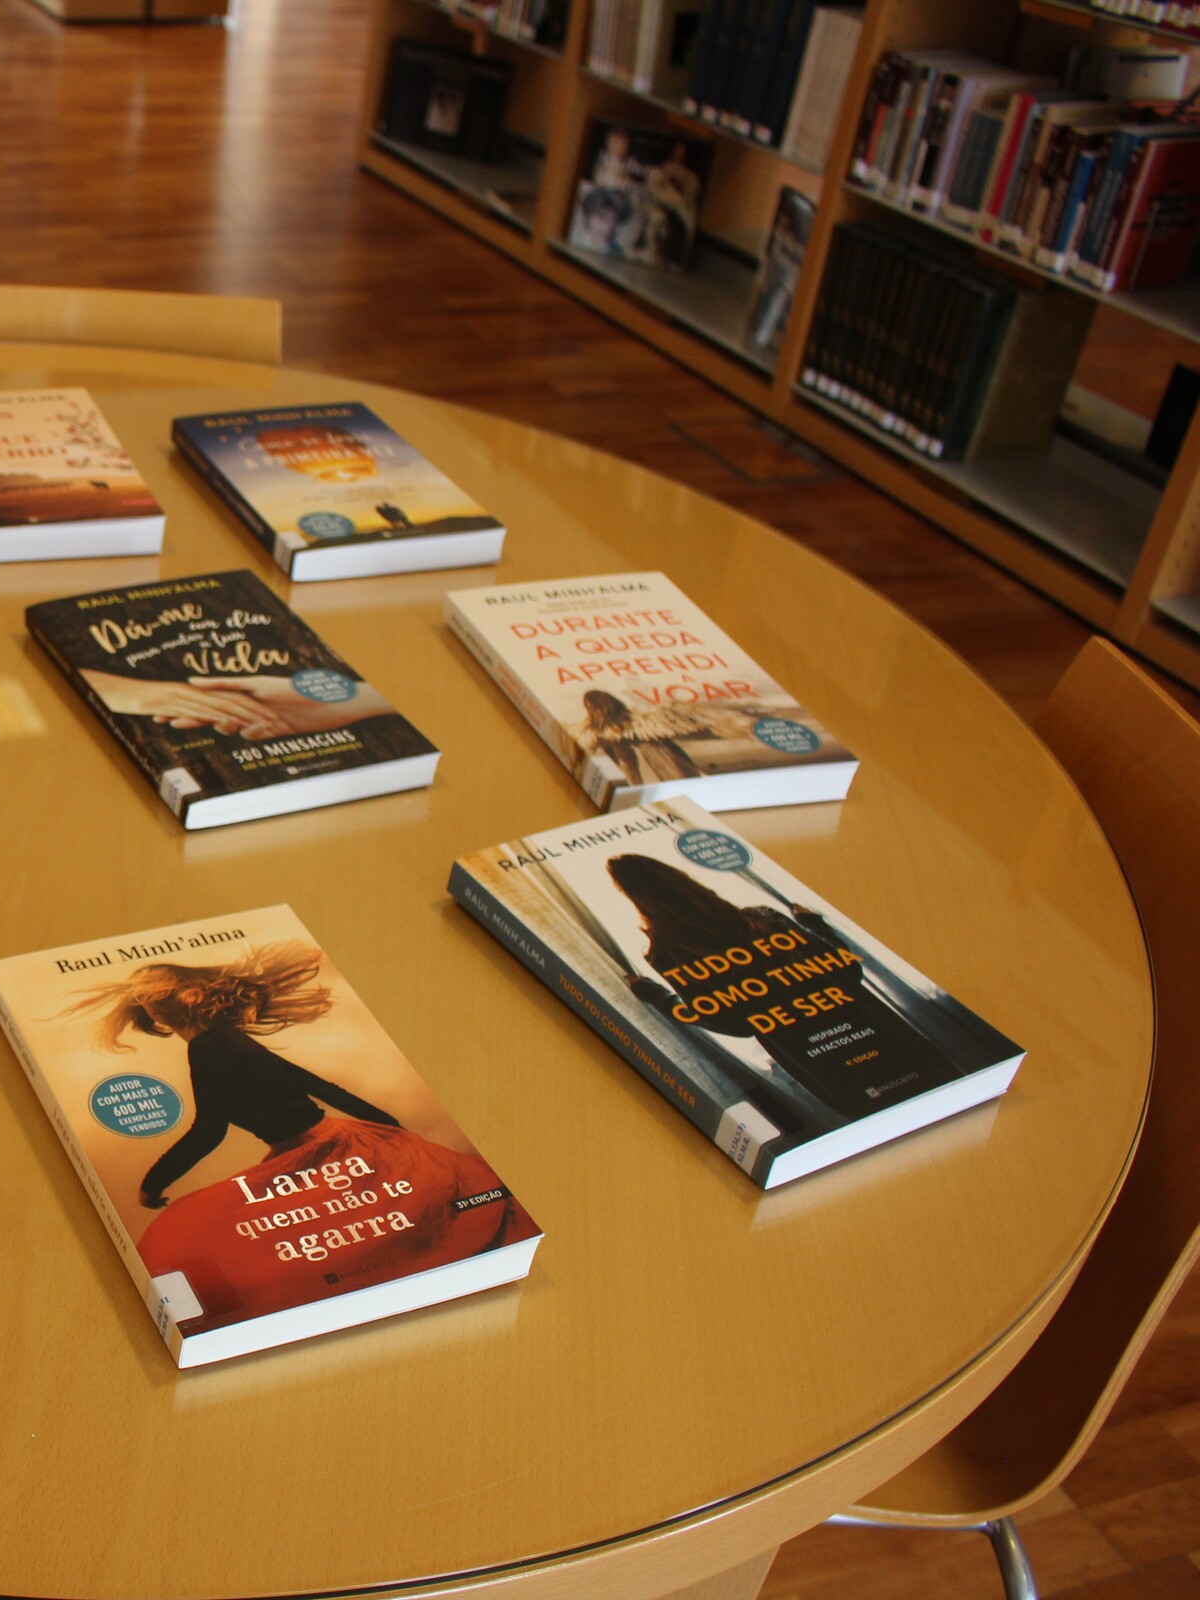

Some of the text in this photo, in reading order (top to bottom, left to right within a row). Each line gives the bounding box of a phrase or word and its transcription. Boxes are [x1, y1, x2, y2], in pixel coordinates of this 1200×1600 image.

[76, 579, 222, 610] RAUL MINH'ALMA
[485, 593, 540, 608] RAUL
[545, 581, 651, 601] MINH'ALMA
[89, 602, 203, 655] Dá-me
[509, 608, 684, 641] DURANTE
[183, 640, 289, 675] Vida
[535, 630, 705, 662] A QUEDA
[556, 652, 730, 686] APRENDI
[680, 672, 697, 684] A
[631, 678, 764, 707] VOAR
[232, 746, 263, 764] 500
[263, 729, 356, 757] MENSAGENS
[498, 812, 684, 873] RAUL MINH'ALMA
[464, 887, 547, 970] RAUL MINH'ALMA
[54, 928, 247, 974] Raul Minh'alma
[663, 929, 809, 987] TUDO FOI
[670, 946, 865, 1025] COMO TINHA
[747, 985, 855, 1035] DE SER
[558, 973, 697, 1108] TUDO FOI COMO TINHA DE SER
[806, 1027, 876, 1058] EM FACTOS REAIS
[808, 1022, 852, 1044] INSPIRADO
[853, 1049, 880, 1064] EDIÇÃO
[97, 1085, 165, 1107] COM MAIS DE
[108, 1078, 143, 1094] AUTOR
[113, 1098, 163, 1118] 600 MIL
[118, 1109, 168, 1127] EXEMPLARES
[128, 1119, 167, 1134] VENDIDOS
[231, 1155, 376, 1205] Larga
[235, 1178, 414, 1242] quem não te
[455, 1189, 504, 1211] 31ª EDIÇÃO
[274, 1209, 416, 1262] agarra
